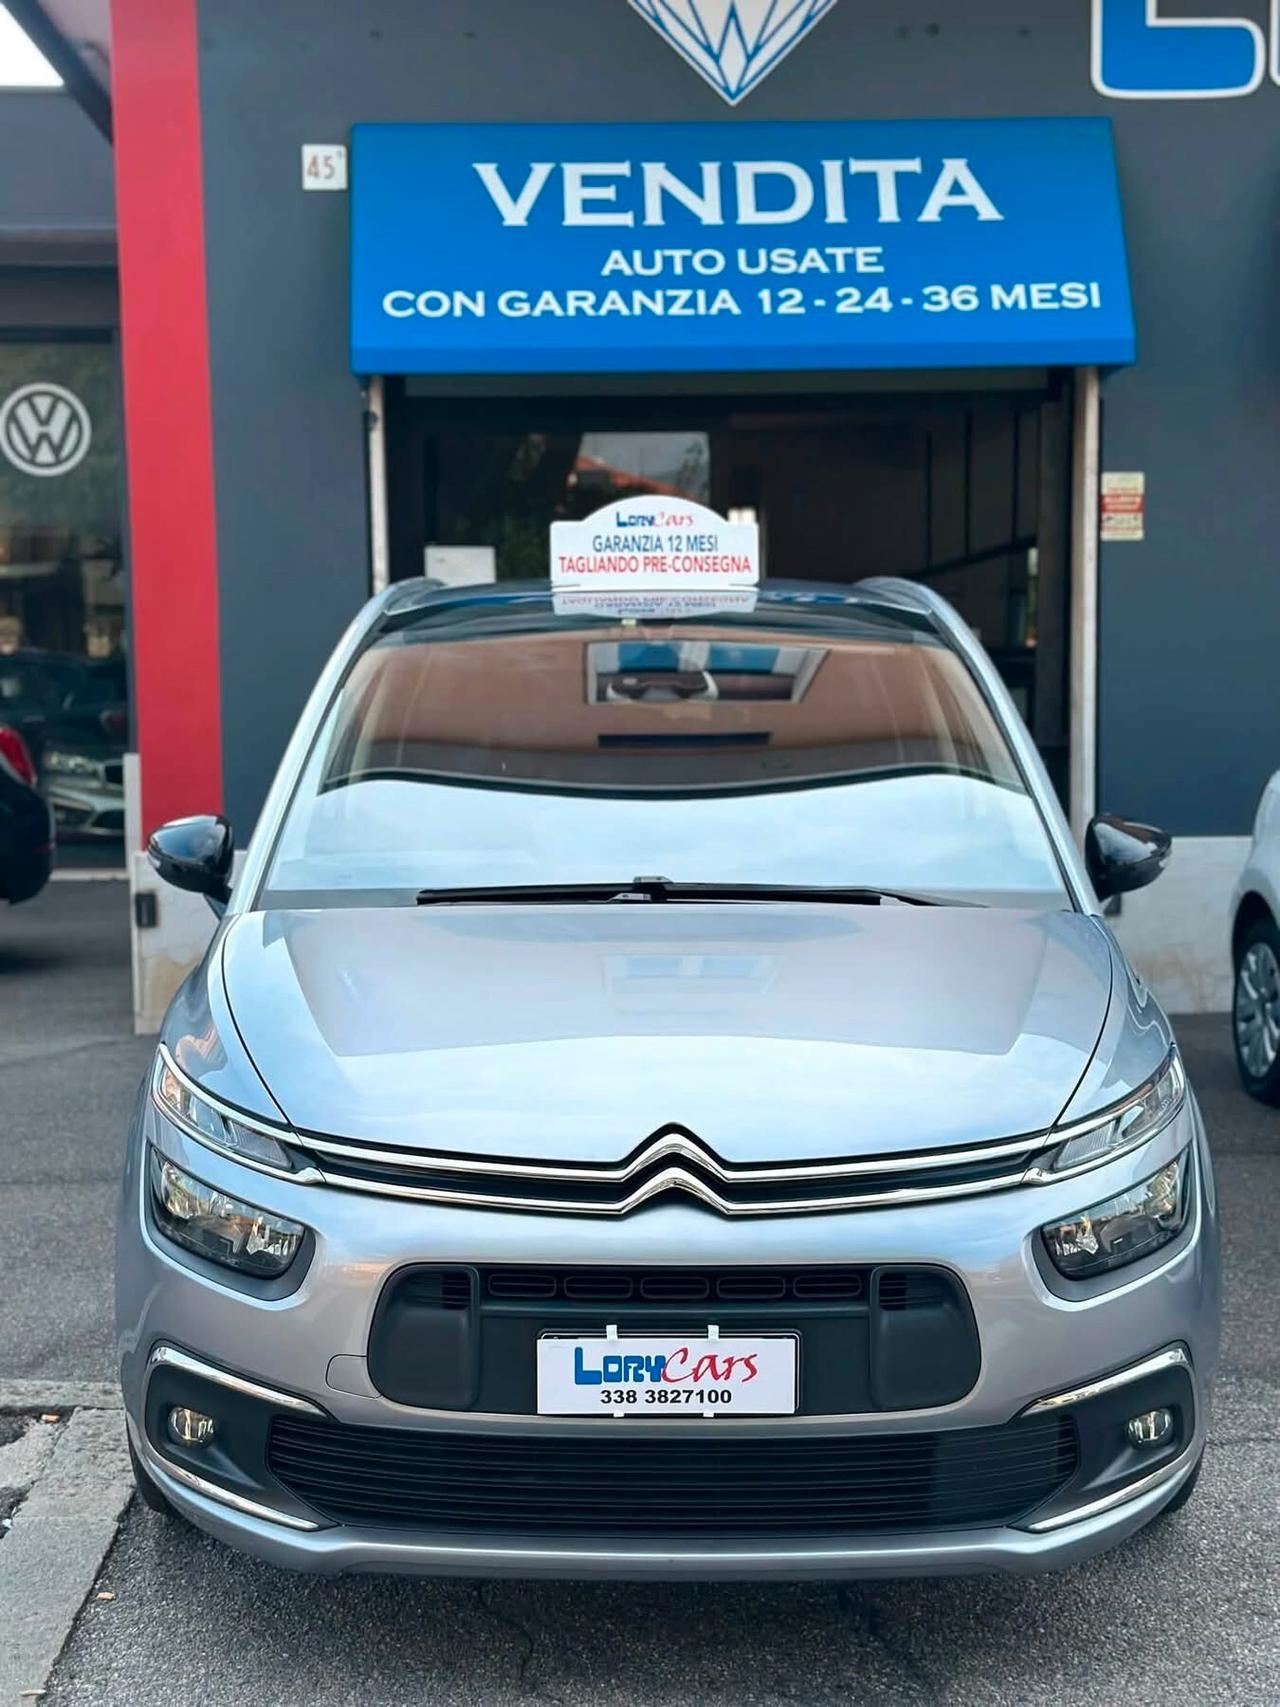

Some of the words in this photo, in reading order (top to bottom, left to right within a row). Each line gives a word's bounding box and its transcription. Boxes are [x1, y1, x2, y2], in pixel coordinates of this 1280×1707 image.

[472, 157, 1005, 227] VENDITA
[601, 249, 726, 276] AUTO
[737, 246, 886, 275] USATE
[382, 290, 486, 318] CON
[497, 288, 742, 317] GARANZIA
[757, 288, 806, 315] 12
[835, 286, 893, 314] 24
[922, 284, 980, 312] 36
[990, 281, 1101, 311] MESI
[592, 535, 664, 553] GARANZIA
[668, 535, 683, 552] 12
[686, 534, 719, 552] MESI
[559, 556, 640, 574] TAGLIANDO
[643, 555, 752, 574] PRE-CONSEGNA
[600, 1389, 638, 1404] 338
[644, 1389, 732, 1404] 3827100
